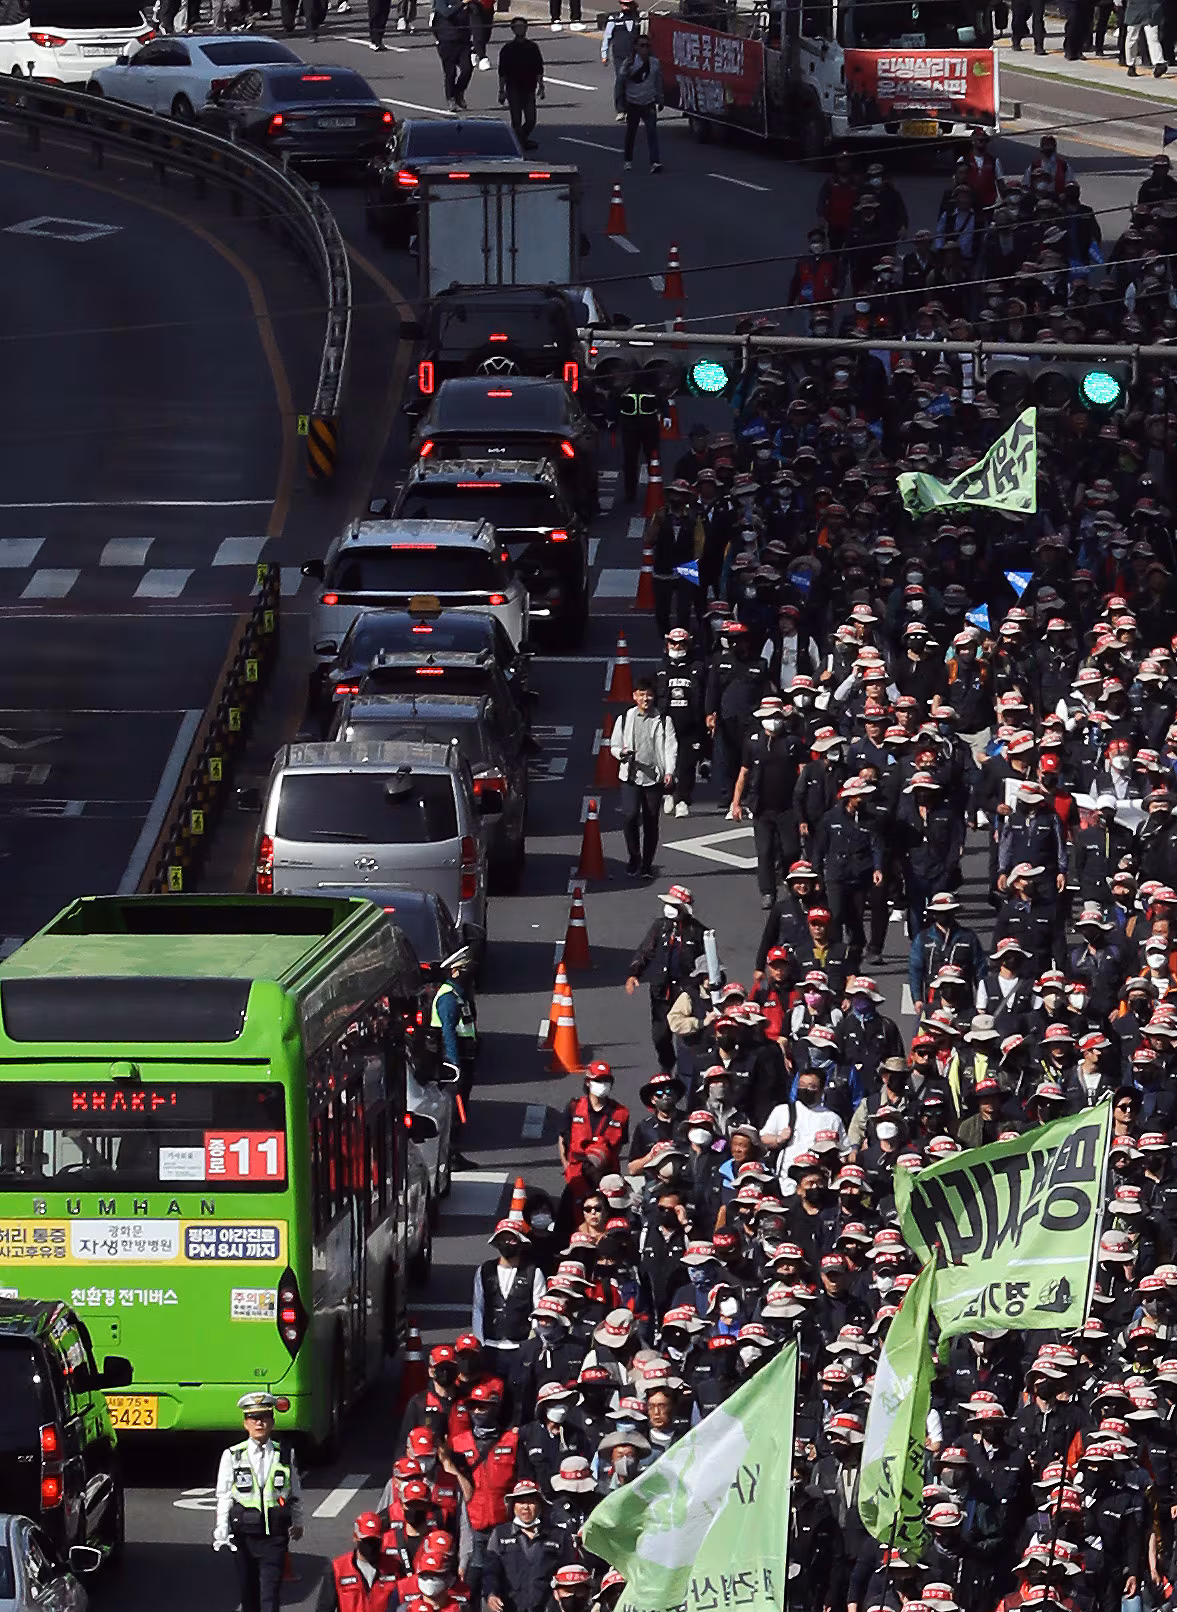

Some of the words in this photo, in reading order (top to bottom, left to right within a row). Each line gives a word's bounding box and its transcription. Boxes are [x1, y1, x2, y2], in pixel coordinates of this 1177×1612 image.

[208, 1138, 226, 1175] 종로
[229, 1137, 278, 1175] 11
[33, 1198, 216, 1216] BUMHAN
[108, 1225, 144, 1239] 광화문
[188, 1228, 217, 1243] 평일
[188, 1244, 217, 1259] PM
[218, 1244, 244, 1259] 8시
[71, 1286, 116, 1307] 친환경
[118, 1288, 179, 1307] 전기버스
[109, 1408, 155, 1427] 5423
